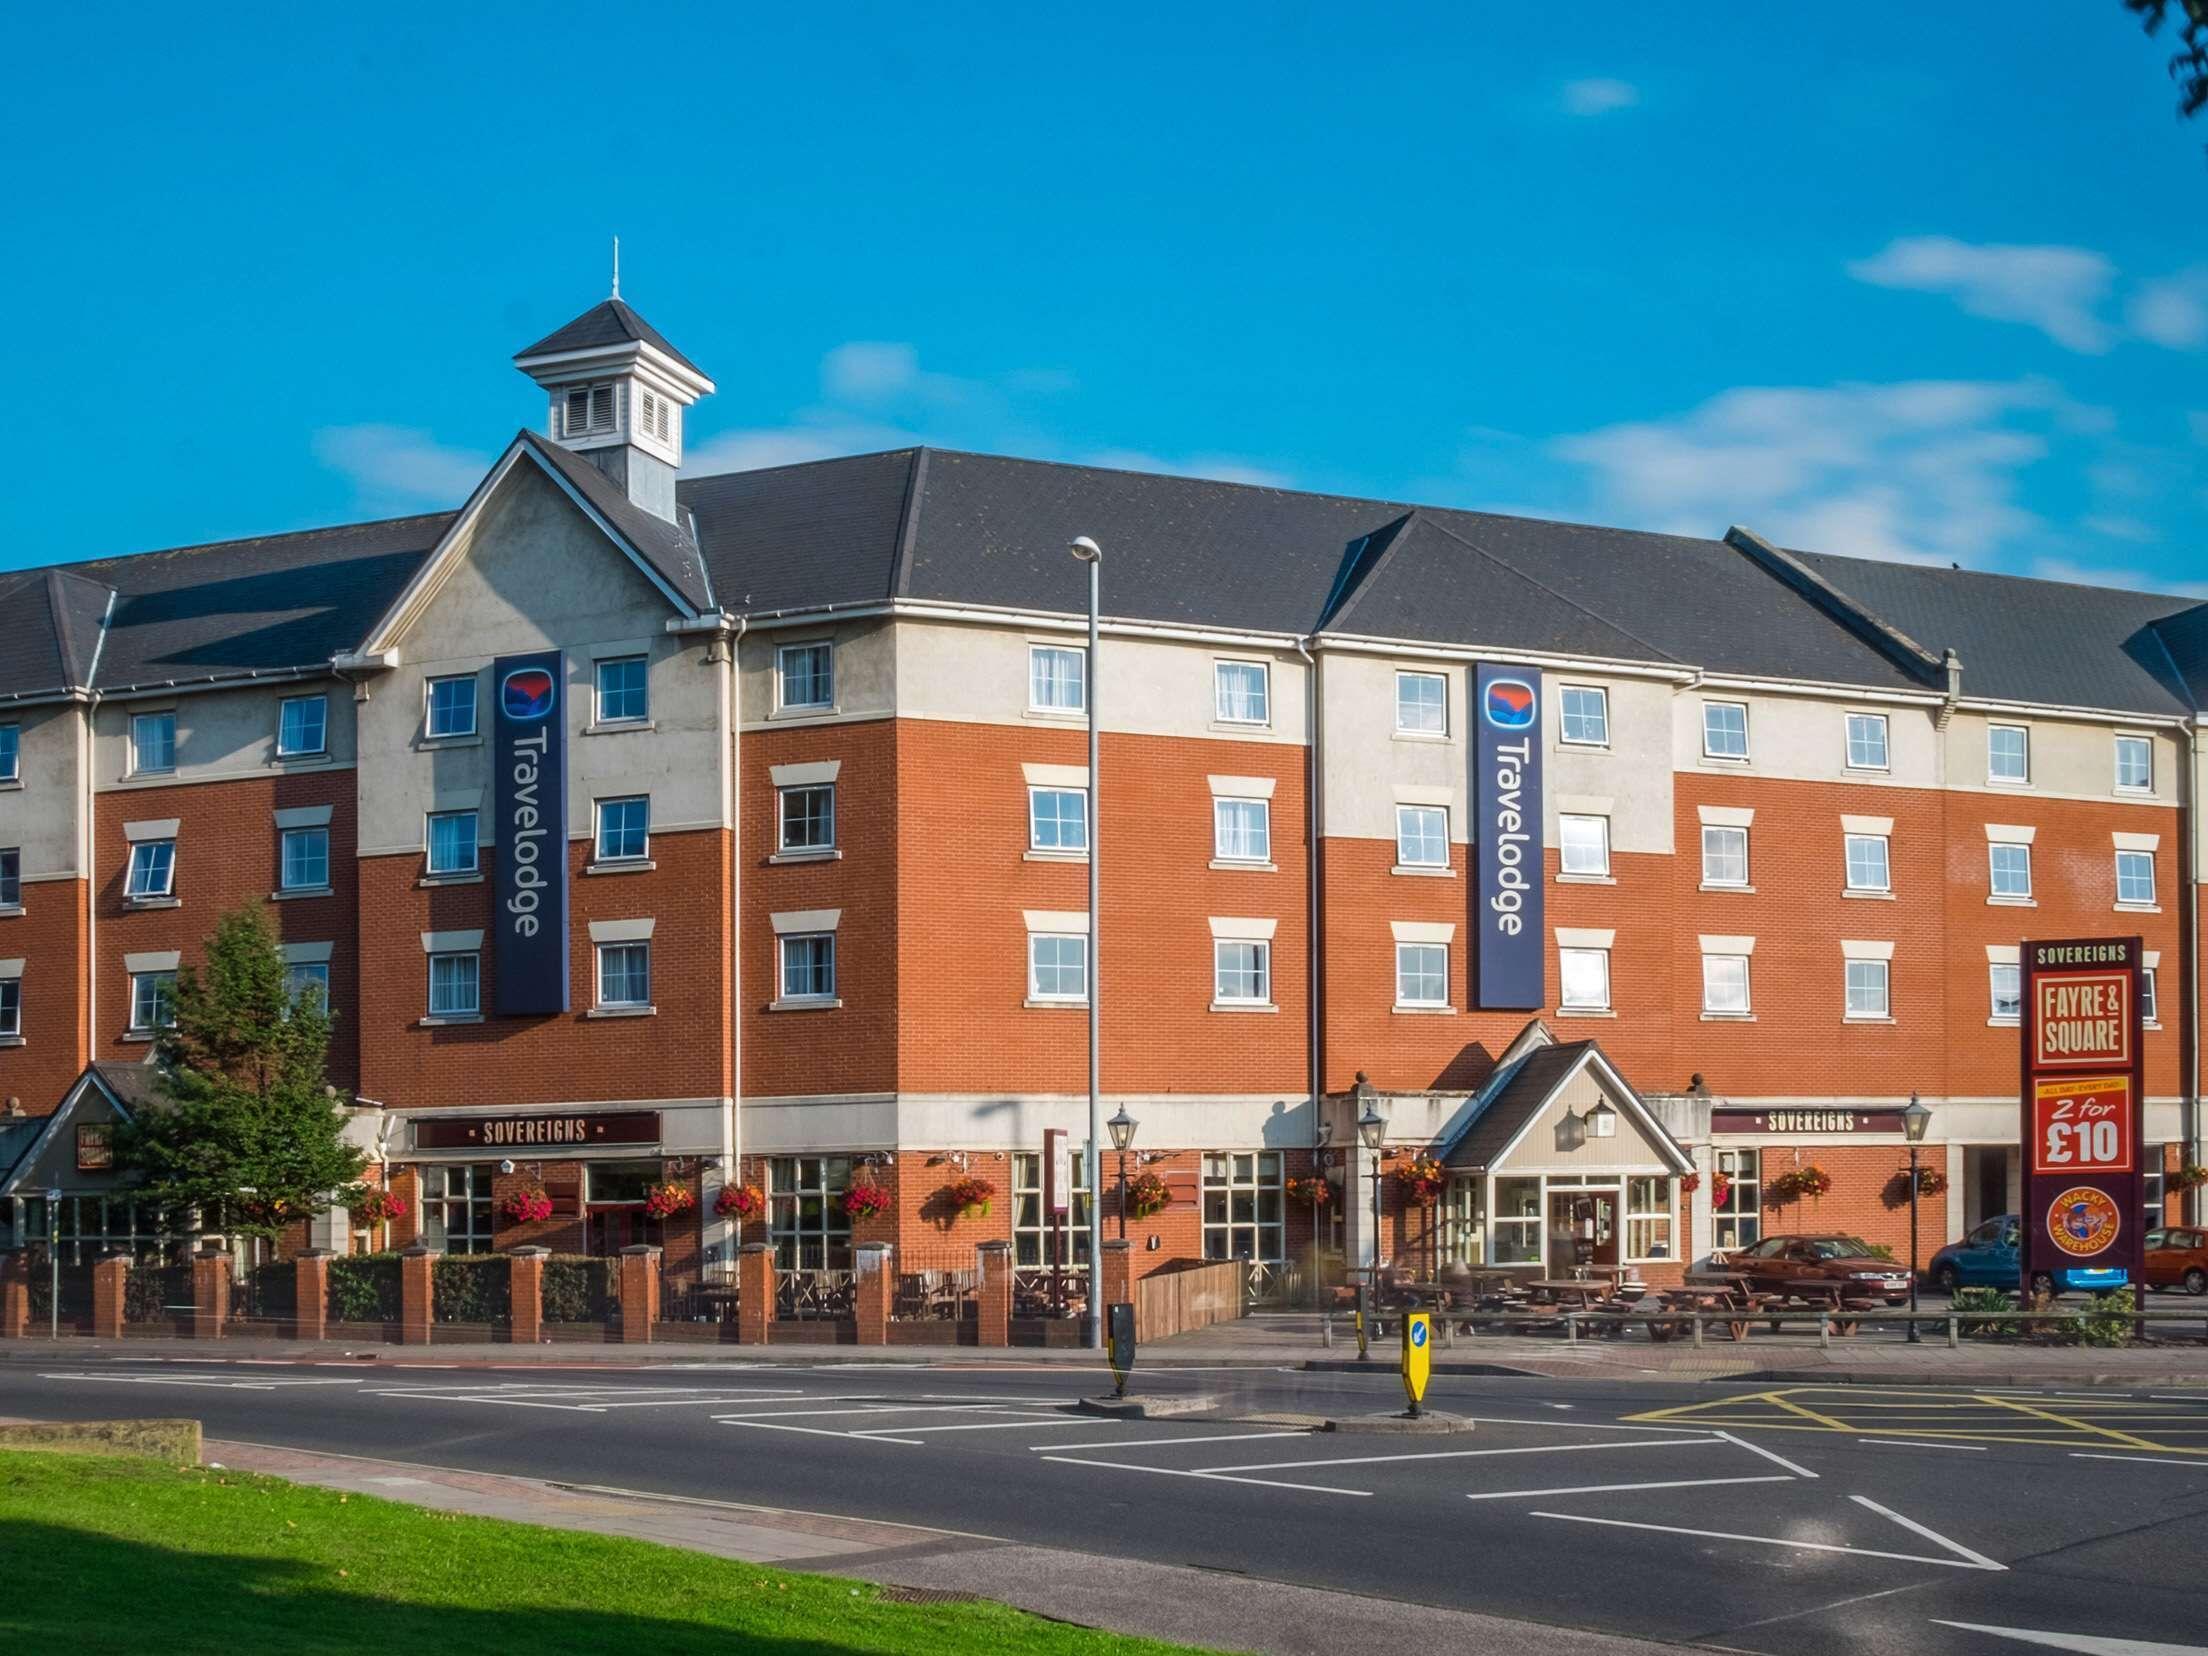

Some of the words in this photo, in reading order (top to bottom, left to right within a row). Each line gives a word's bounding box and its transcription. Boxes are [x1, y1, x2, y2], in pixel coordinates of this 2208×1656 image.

[507, 726, 548, 937] Travelodge
[1491, 737, 1530, 935] Travelodge
[2037, 945, 2126, 964] SOVEREIGNS
[2045, 985, 2104, 1018] FAYRE
[2106, 985, 2119, 1016] &
[2045, 1019, 2119, 1054] SQUARE
[1768, 1110, 1854, 1131] SOVEREIGNS
[2051, 1099, 2074, 1120] 2
[2079, 1097, 2116, 1118] for
[484, 1119, 586, 1144] SOVEREIGNS
[2046, 1121, 2118, 1162] £10
[2060, 1191, 2106, 1207] WACKY
[2053, 1223, 2114, 1251] WAREHOUSE
